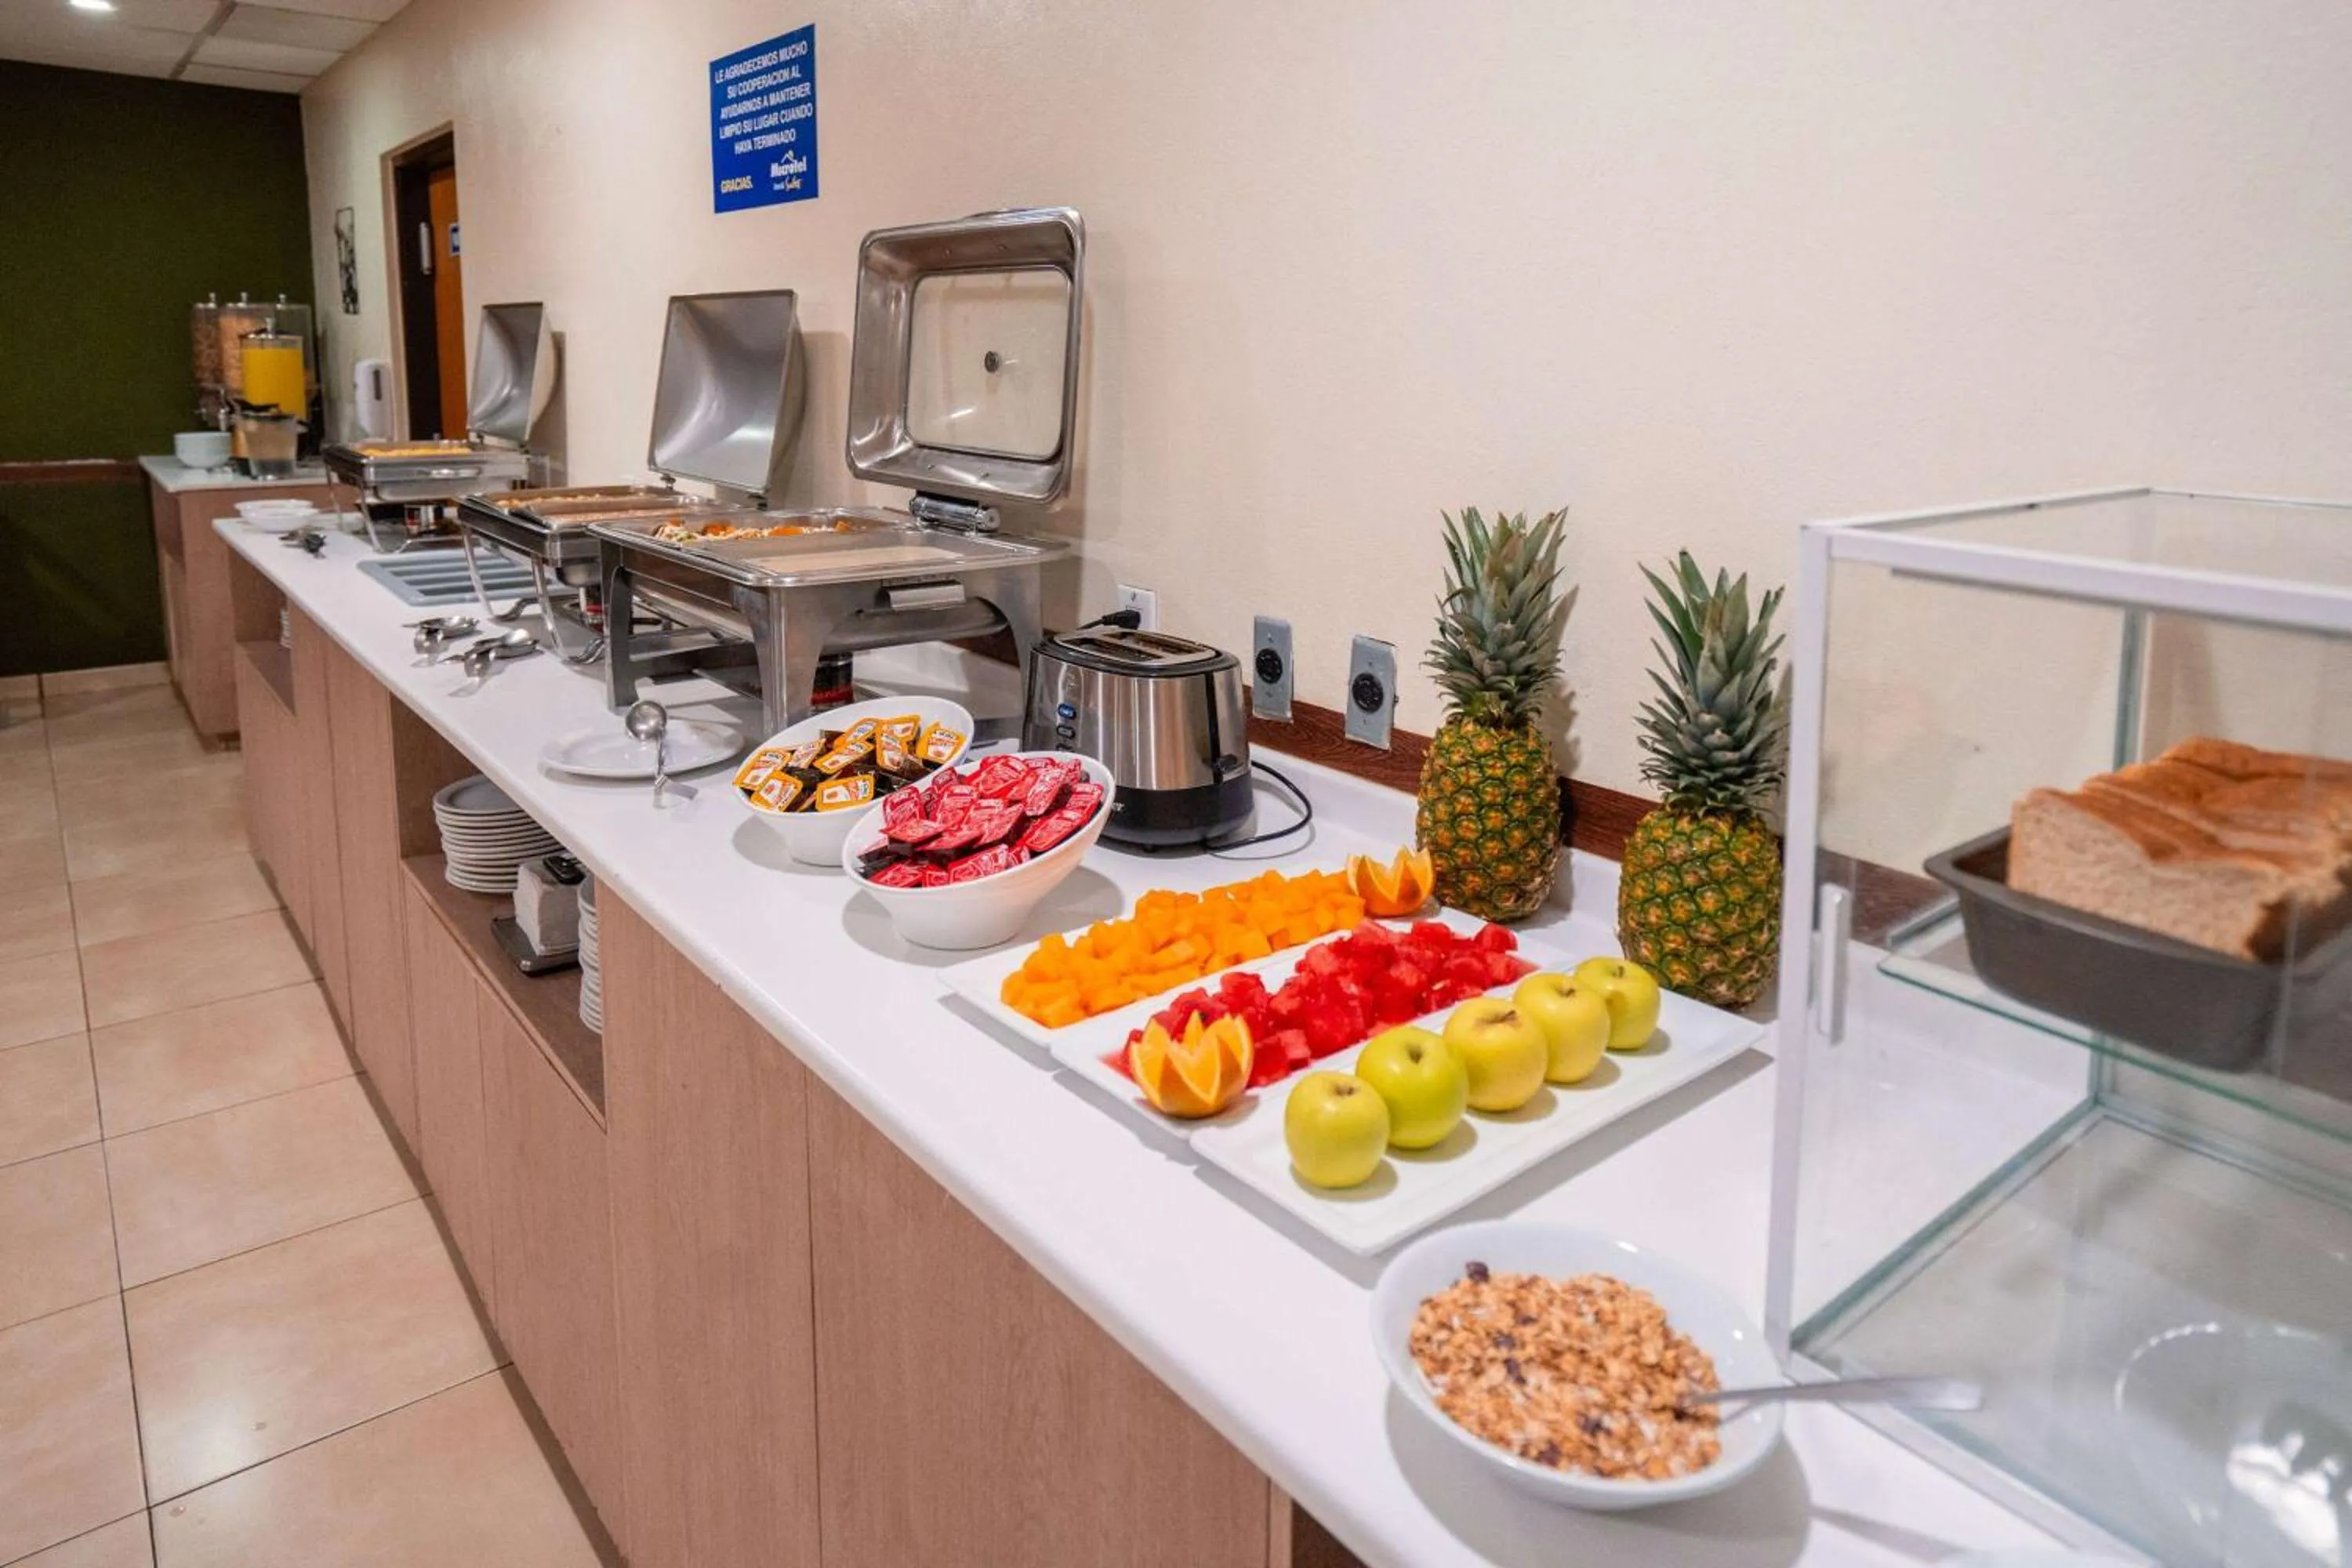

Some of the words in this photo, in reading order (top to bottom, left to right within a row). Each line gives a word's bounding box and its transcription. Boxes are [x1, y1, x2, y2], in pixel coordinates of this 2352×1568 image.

[714, 69, 724, 84] LE
[779, 40, 808, 63] MUCHO
[727, 85, 737, 100] SU
[738, 67, 789, 96] COOPERACION
[790, 64, 802, 80] AL
[763, 95, 769, 107] A
[769, 82, 811, 107] MANTENER
[742, 118, 753, 134] SU
[753, 112, 779, 131] LUGAR
[779, 103, 813, 124] CUANDO
